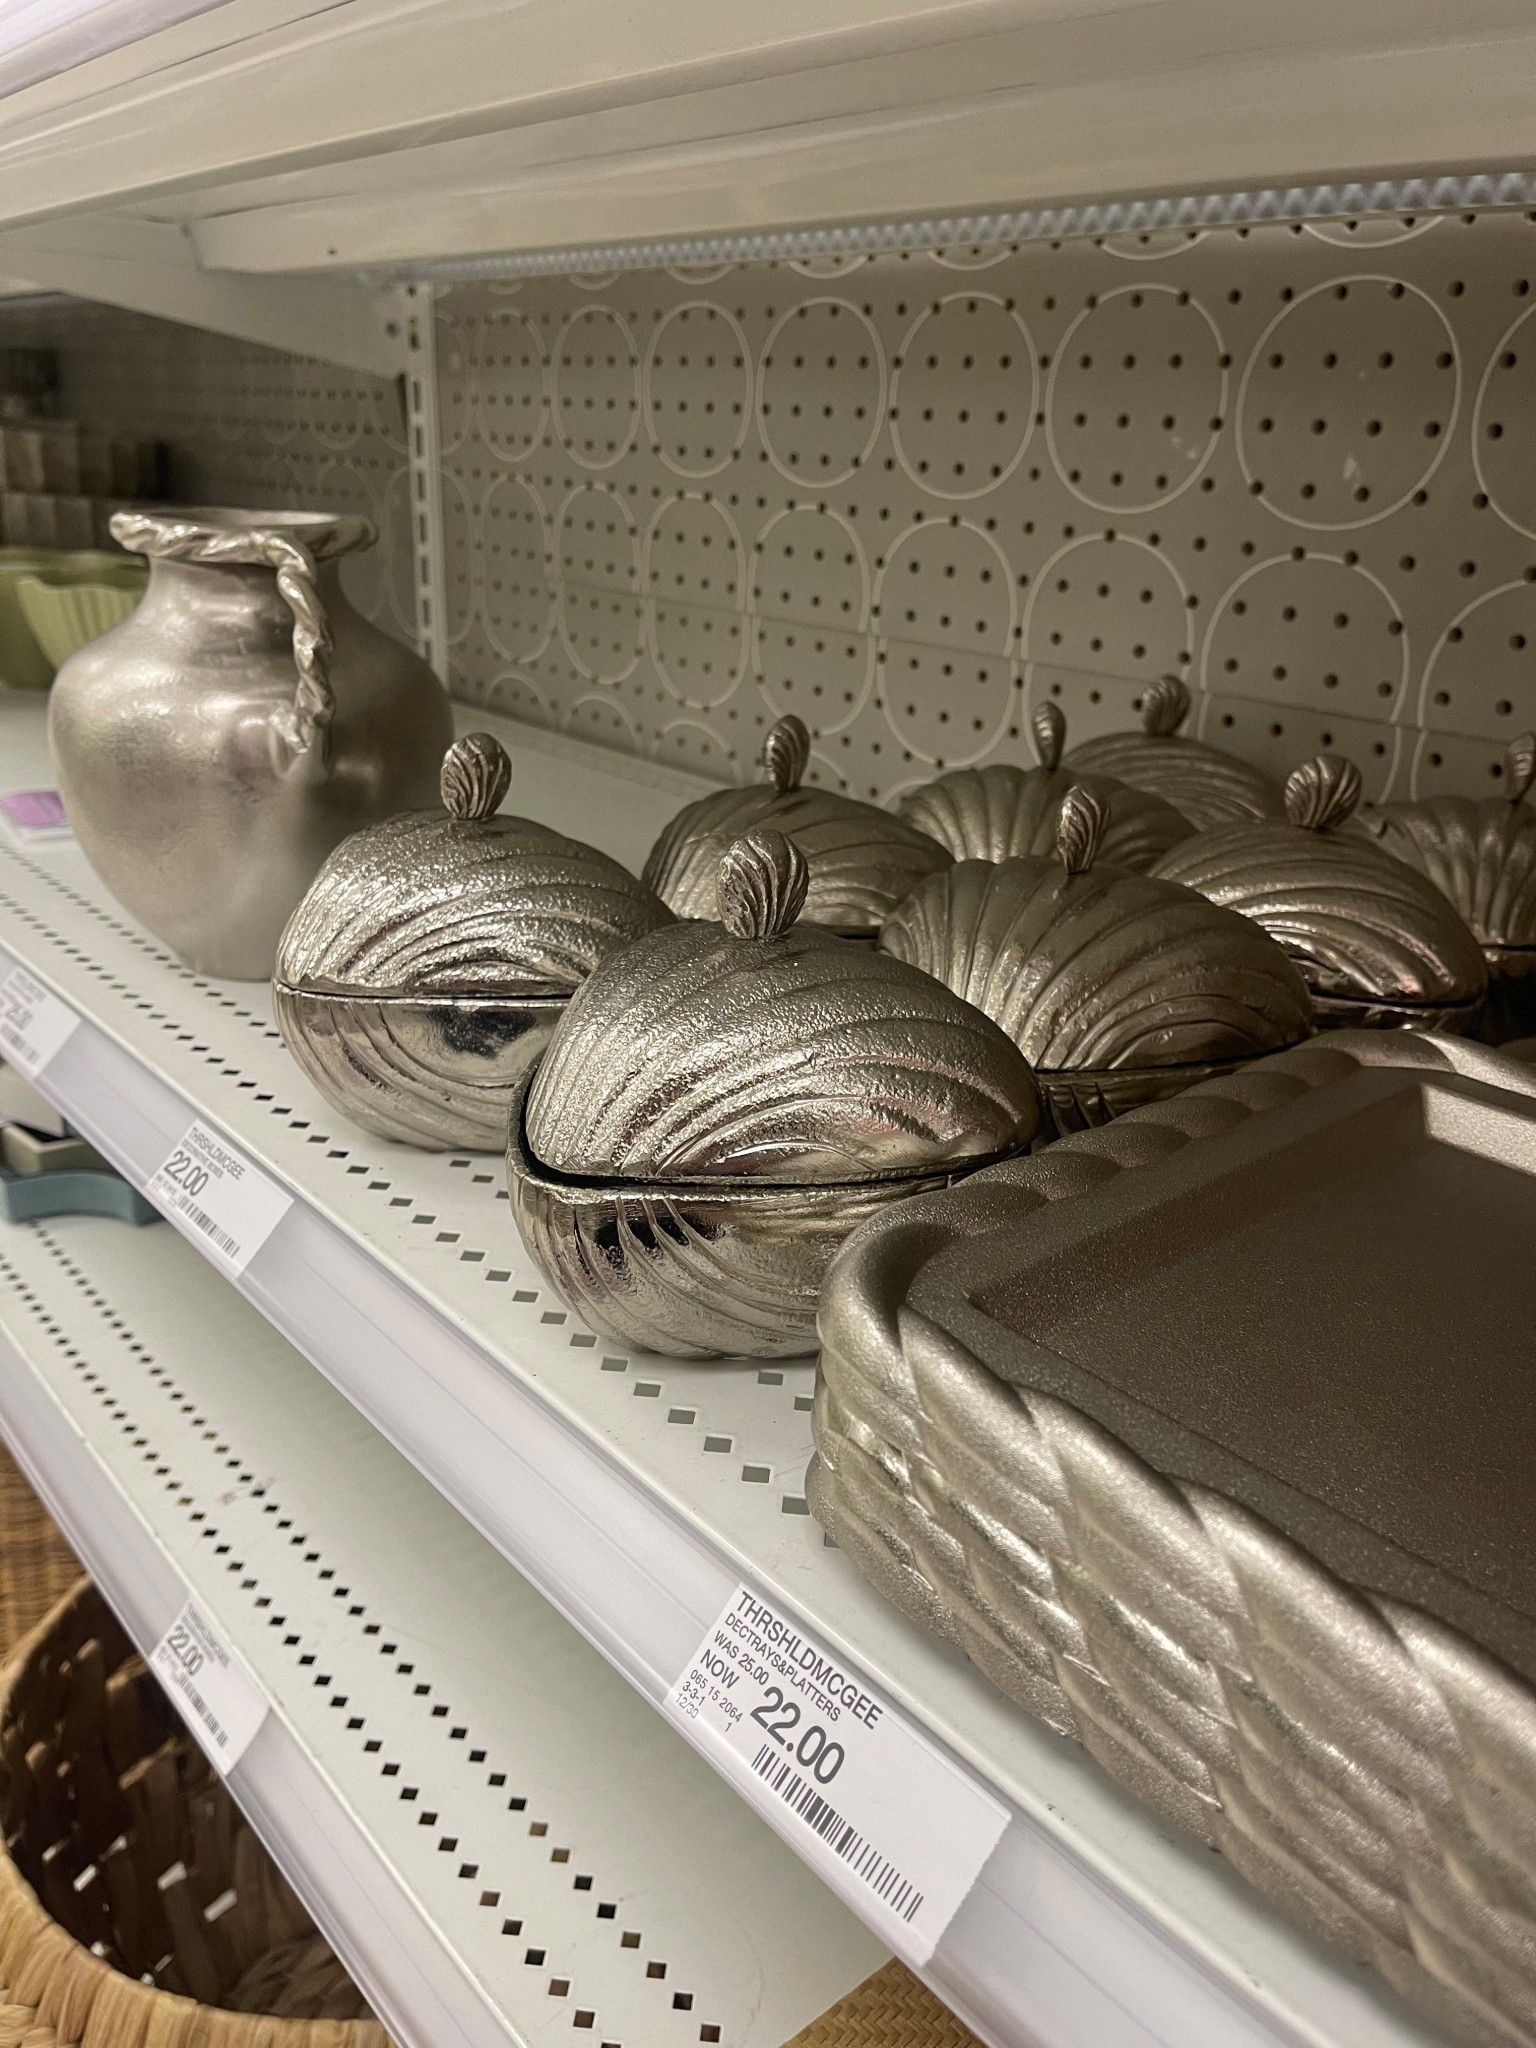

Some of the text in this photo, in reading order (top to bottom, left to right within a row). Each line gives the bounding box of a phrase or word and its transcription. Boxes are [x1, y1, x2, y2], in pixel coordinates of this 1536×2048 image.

[164, 1151, 209, 1196] 22.00
[167, 1624, 205, 1676] 22.00
[714, 1630, 770, 1685] WAS 25.00
[724, 1612, 841, 1721] DECTRAYS&PLATTERS
[737, 1591, 883, 1730] THRSHLDMCGEE
[675, 1693, 699, 1719] 12/30
[682, 1681, 733, 1733] 3-3-1 1
[690, 1669, 743, 1722] 065 15 2064
[700, 1648, 845, 1784] NOW 22.00
